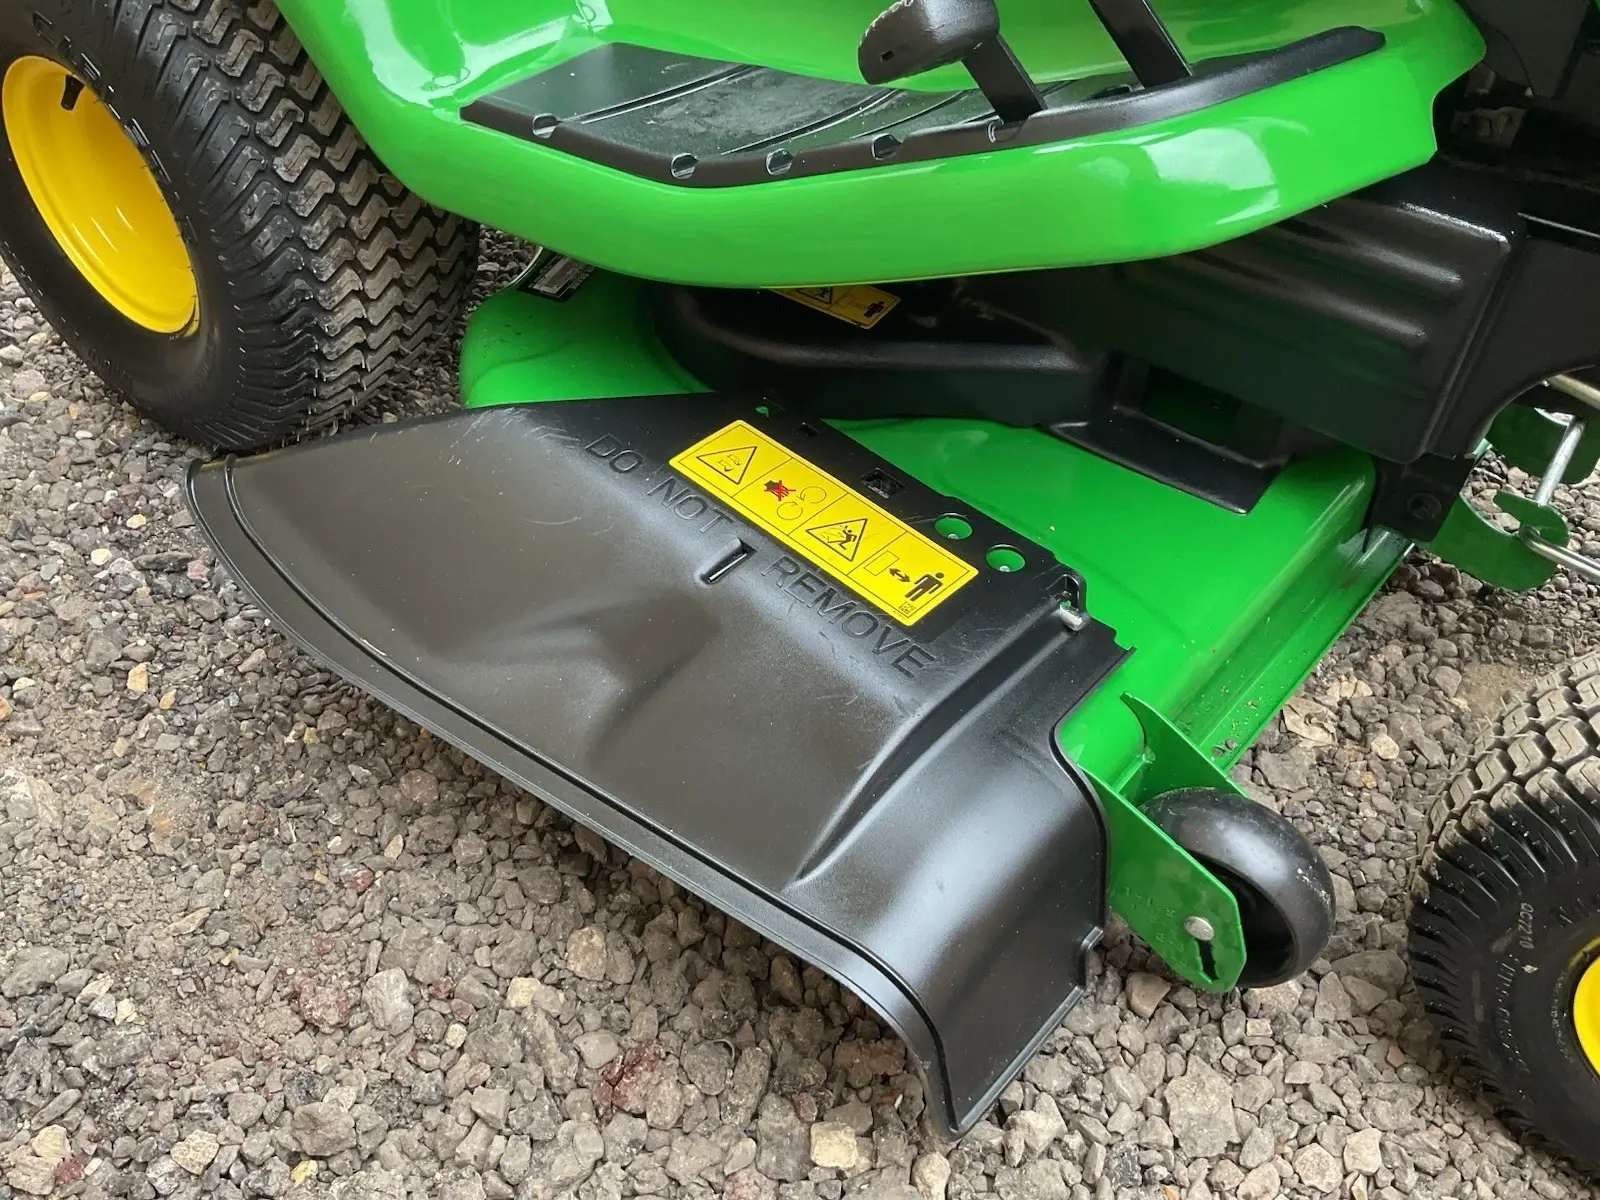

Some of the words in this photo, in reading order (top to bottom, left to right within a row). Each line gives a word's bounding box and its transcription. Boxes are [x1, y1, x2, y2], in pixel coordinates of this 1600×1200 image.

[585, 433, 644, 474] DO
[647, 475, 736, 534] NOT
[760, 555, 941, 680] REMOVE
